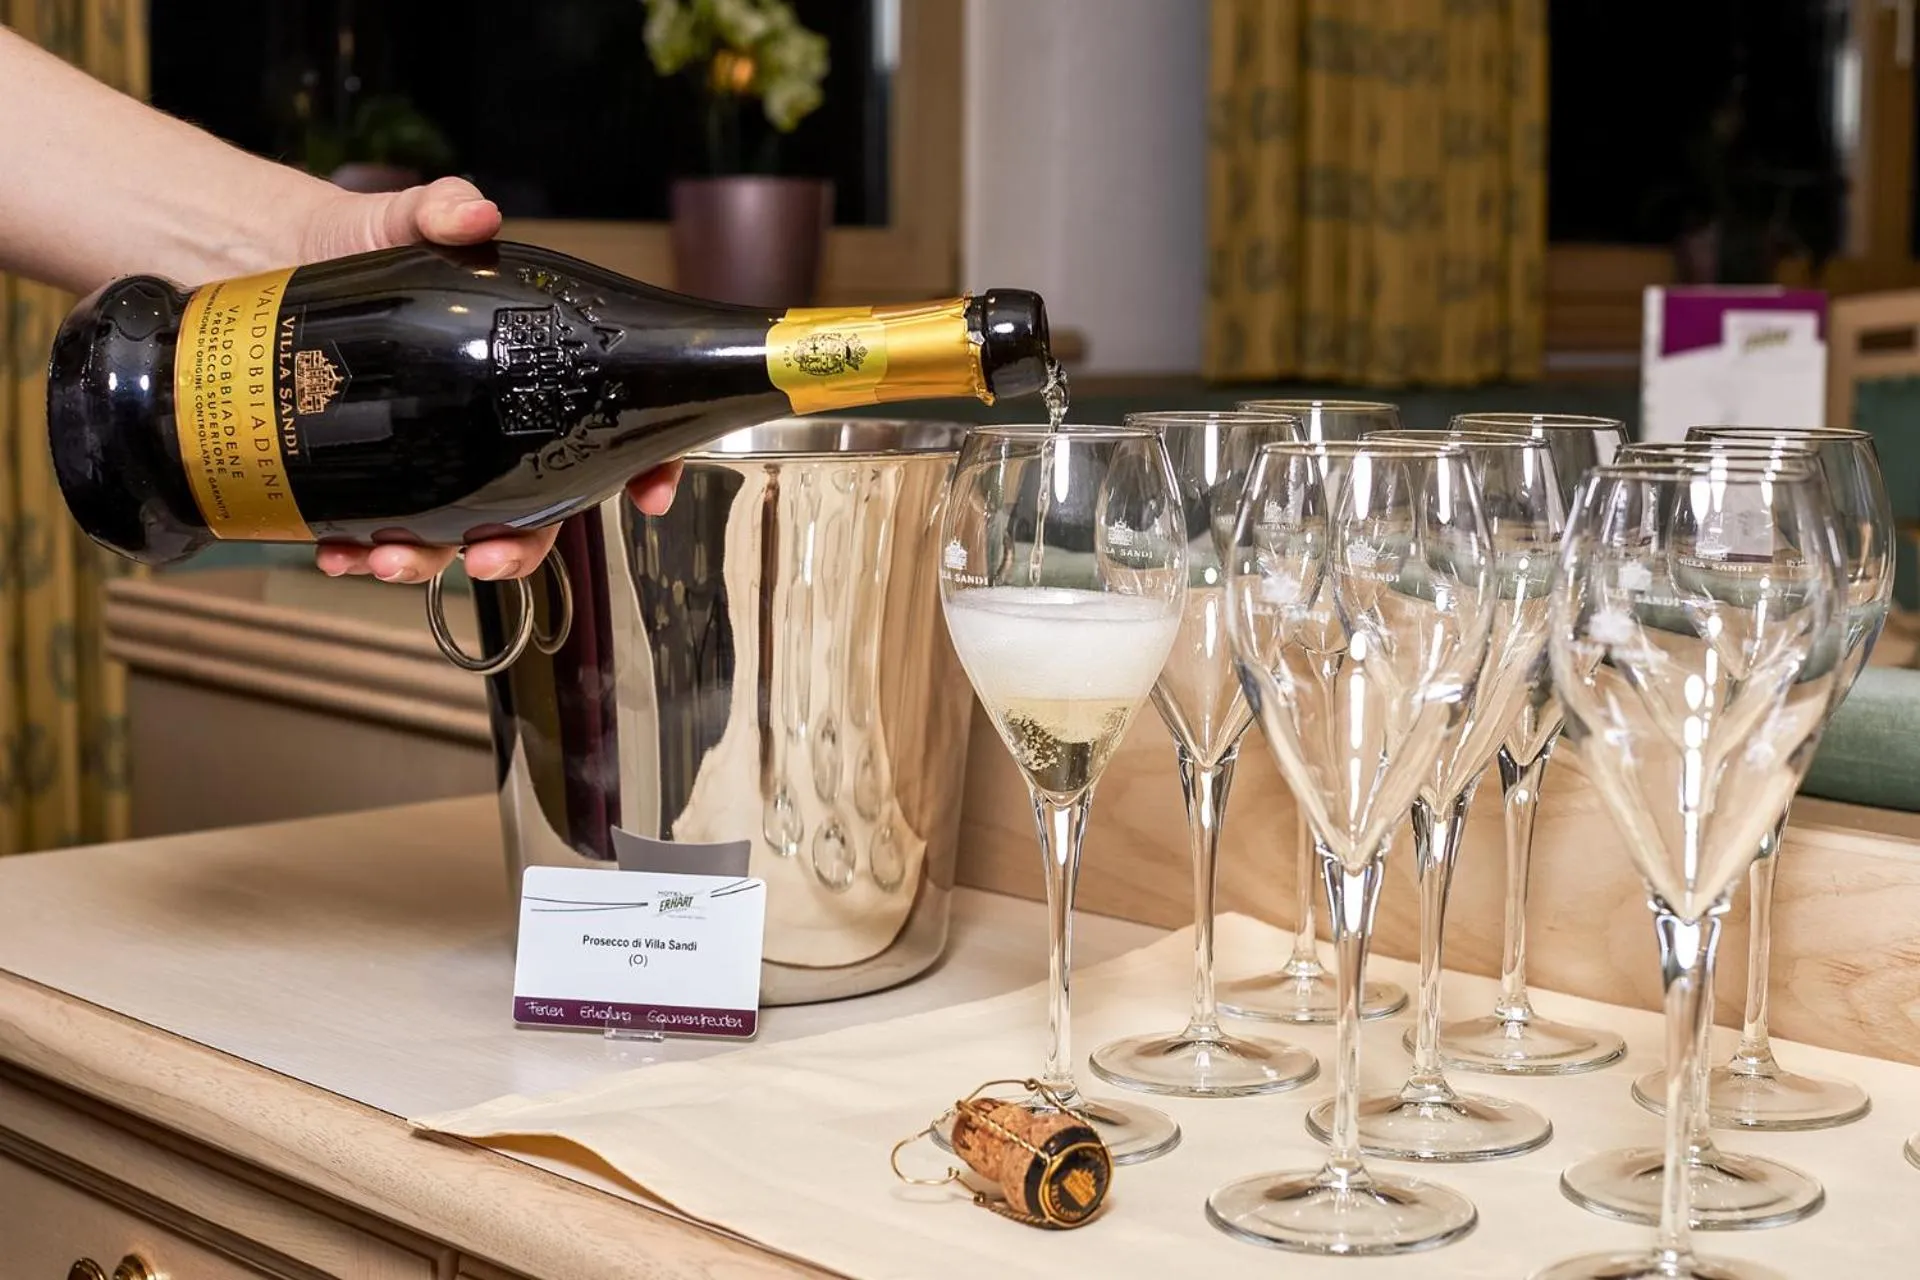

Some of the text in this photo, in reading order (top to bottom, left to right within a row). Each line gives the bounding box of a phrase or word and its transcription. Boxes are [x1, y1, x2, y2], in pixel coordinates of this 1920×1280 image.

[194, 350, 205, 391] ORIGINE
[279, 315, 300, 456] VILLA SANDI
[206, 311, 228, 475] PROSECCO SUPERIORE
[220, 304, 245, 480] VALDOBBIADENE
[249, 283, 284, 502] VALDOBBIADENE
[195, 394, 212, 467] CONTROLLATA
[954, 571, 989, 586] SANDI
[1711, 562, 1753, 573] SANDI
[658, 895, 694, 913] ERHART
[582, 934, 698, 951] Prosecco di Villa Sandi
[628, 953, 649, 967] (O)
